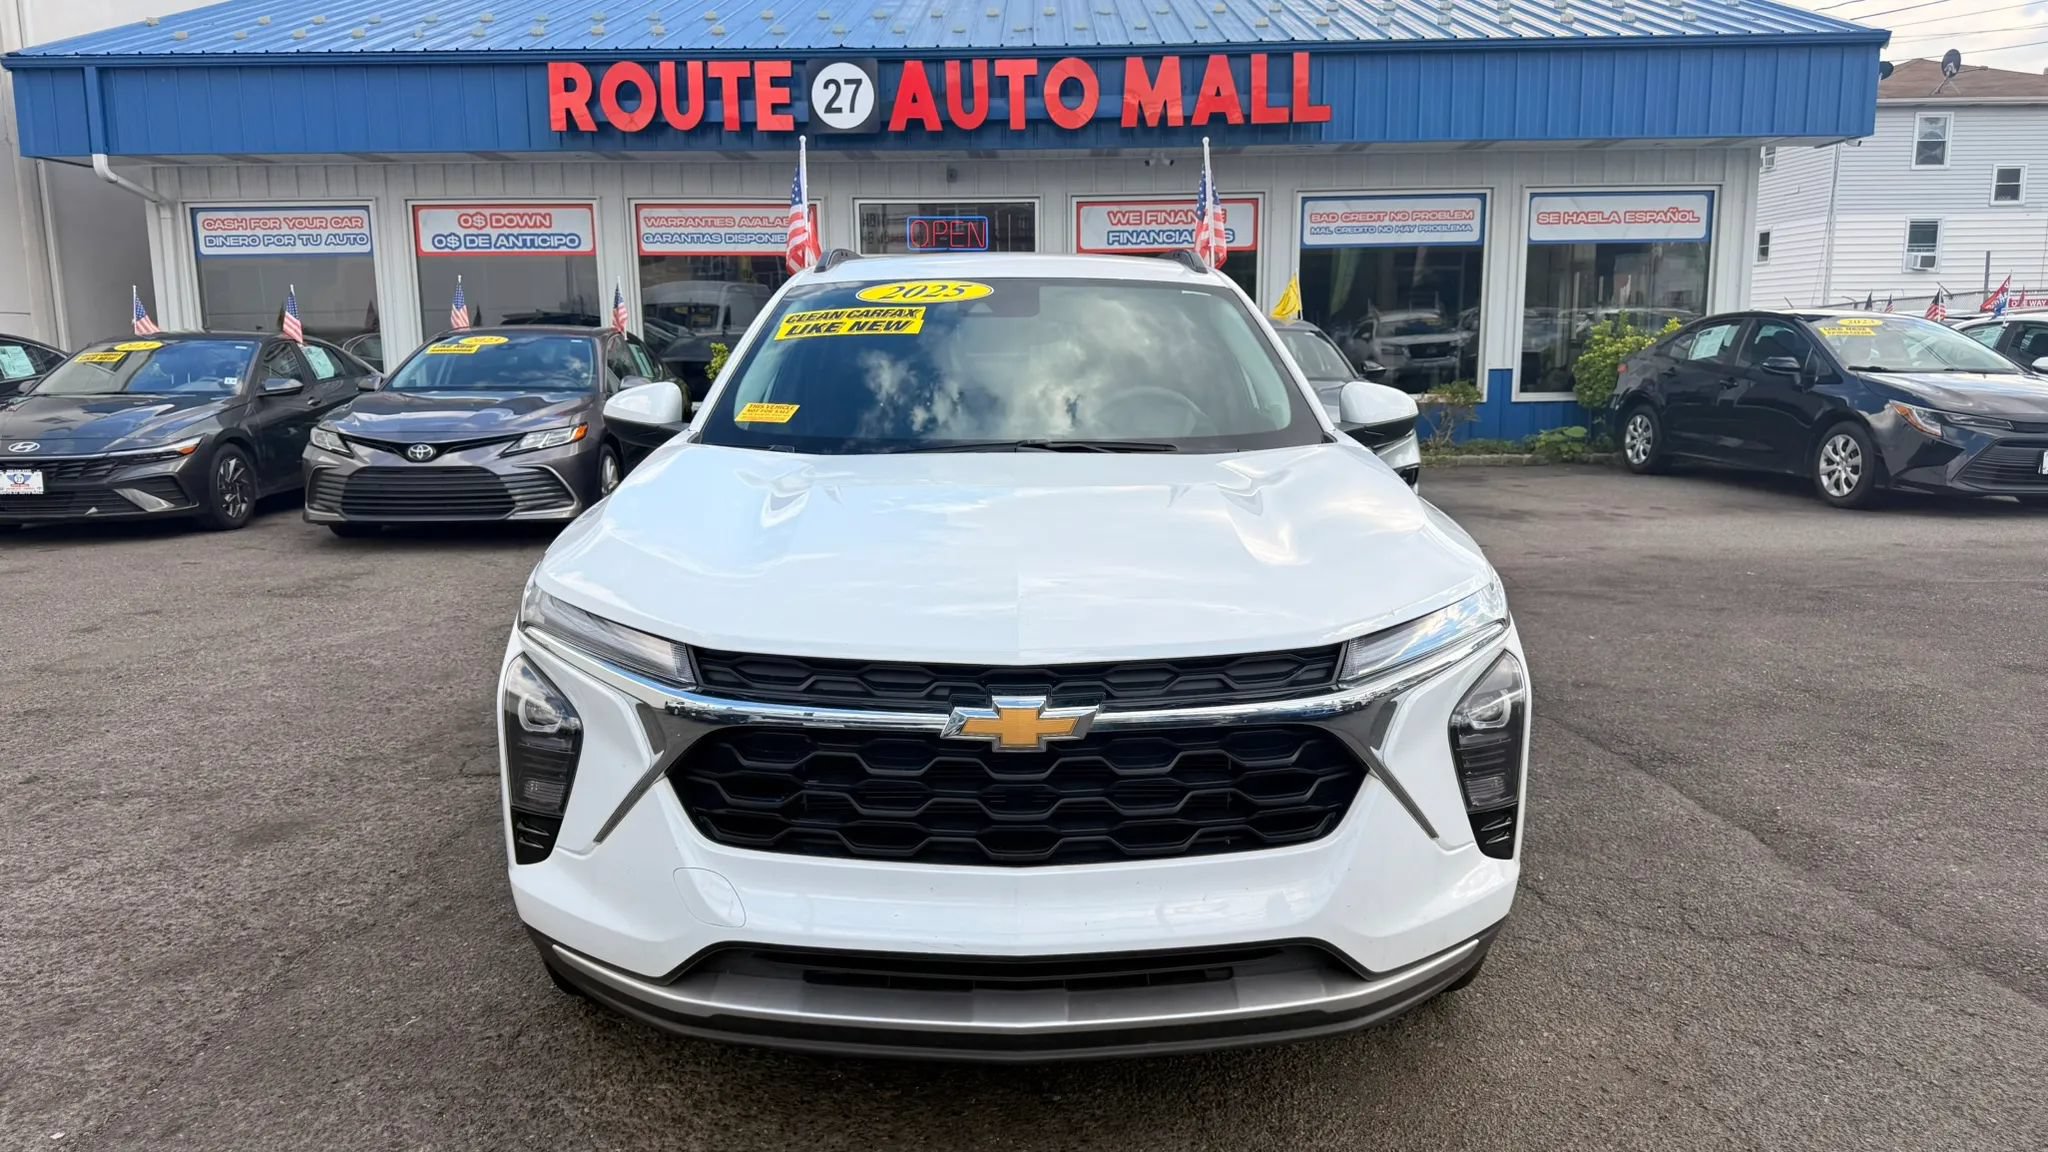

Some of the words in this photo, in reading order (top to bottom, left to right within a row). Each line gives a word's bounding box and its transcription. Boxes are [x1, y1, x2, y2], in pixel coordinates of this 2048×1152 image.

[547, 60, 795, 132] ROUTE
[822, 78, 863, 115] 27
[888, 57, 1099, 131] AUTO
[1120, 51, 1331, 129] MALL
[203, 218, 247, 231] CASH
[250, 217, 281, 230] FOR
[283, 216, 328, 230] YOUR
[330, 216, 363, 229] CAR
[490, 213, 552, 229] DOWN
[644, 216, 735, 228] WARRANTIES
[1107, 210, 1141, 226] WE
[1310, 211, 1338, 224] BAD
[1341, 211, 1387, 222] CREDIT
[1389, 210, 1409, 221] NO
[1411, 209, 1475, 222] PROBLEM
[1537, 211, 1561, 225] SE
[1562, 210, 1620, 224] HABLA
[1623, 207, 1700, 224] ESPAÑOL
[910, 220, 985, 248] OPEN
[1310, 226, 1333, 236] MAL
[1334, 225, 1377, 235] CREDITO
[1378, 224, 1393, 234] NO
[1394, 224, 1417, 234] HAY
[1417, 223, 1473, 233] PROBLEMA
[205, 235, 260, 247] DINERO
[263, 234, 295, 247] POR
[299, 233, 321, 246] TU
[325, 232, 369, 246] AUTO
[464, 234, 491, 248] DE
[494, 233, 581, 249] ANTICIPO
[643, 233, 721, 244] GARANTIAS
[879, 284, 971, 300] 2025
[2029, 299, 2047, 307] WAY
[785, 310, 845, 324] CLEAN
[847, 307, 921, 320] CARFAX
[784, 321, 843, 336] LIKE
[847, 319, 912, 333] NEW
